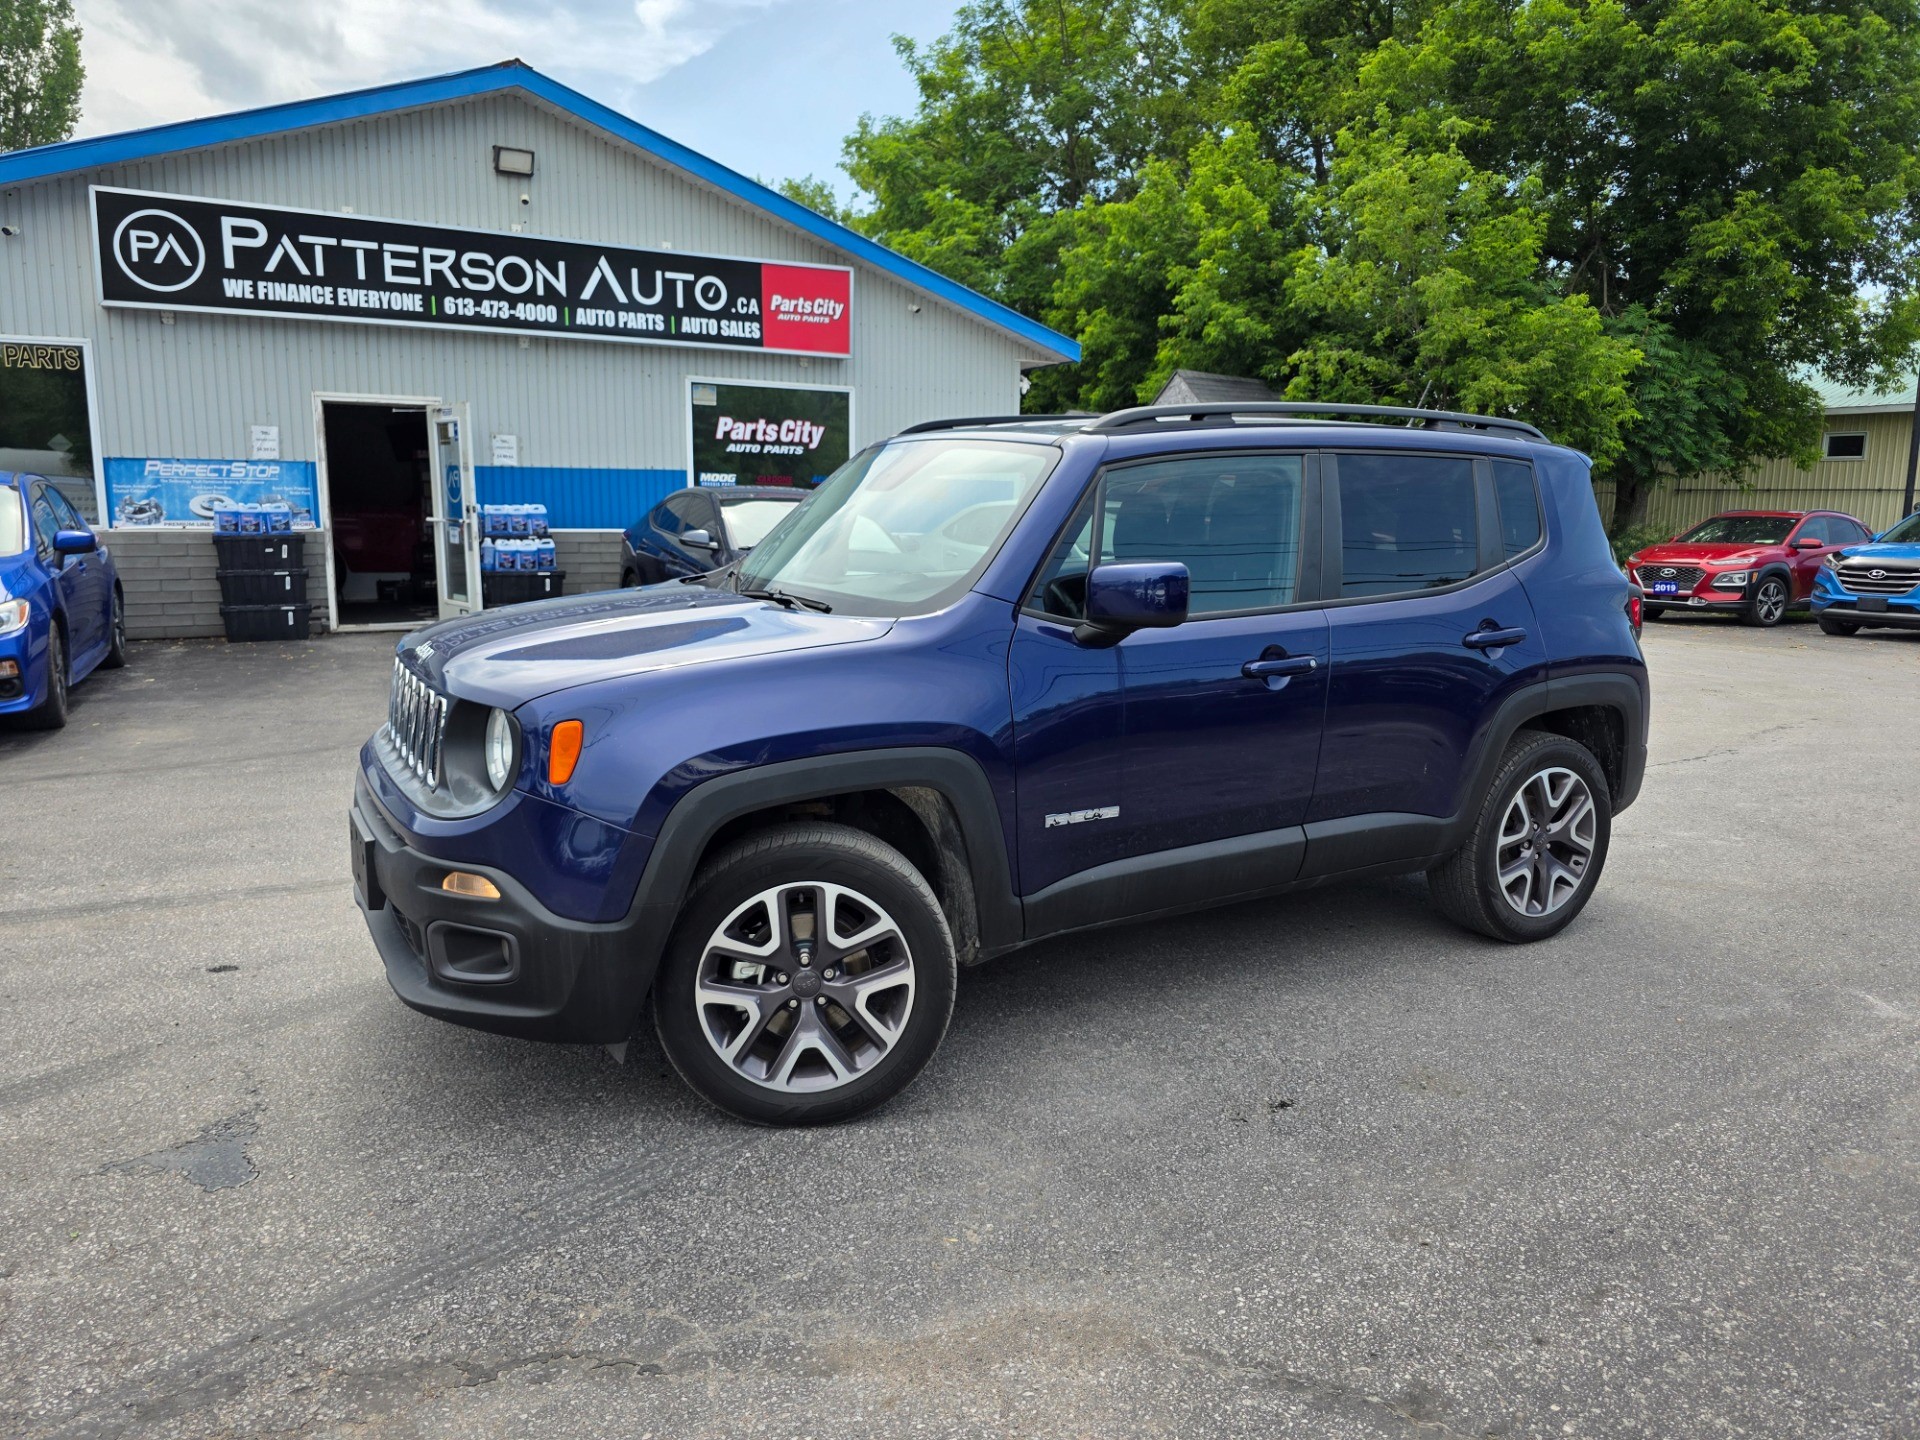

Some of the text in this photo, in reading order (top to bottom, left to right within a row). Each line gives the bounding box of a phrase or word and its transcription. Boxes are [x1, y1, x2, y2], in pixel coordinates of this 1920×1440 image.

[129, 229, 193, 267] PA
[220, 215, 567, 298] PATTERSON
[222, 278, 424, 313] WE FINANCE EVERYONE
[443, 296, 558, 323] 613-473-4000
[575, 307, 665, 332] AUTO PARTS
[777, 313, 830, 324] AUTO PARTS
[681, 316, 761, 339] AUTO SALES
[3, 344, 80, 371] PARTS
[725, 443, 804, 455] AUTO PARTS
[700, 472, 737, 483] MOOG
[1654, 584, 1677, 592] 2019
